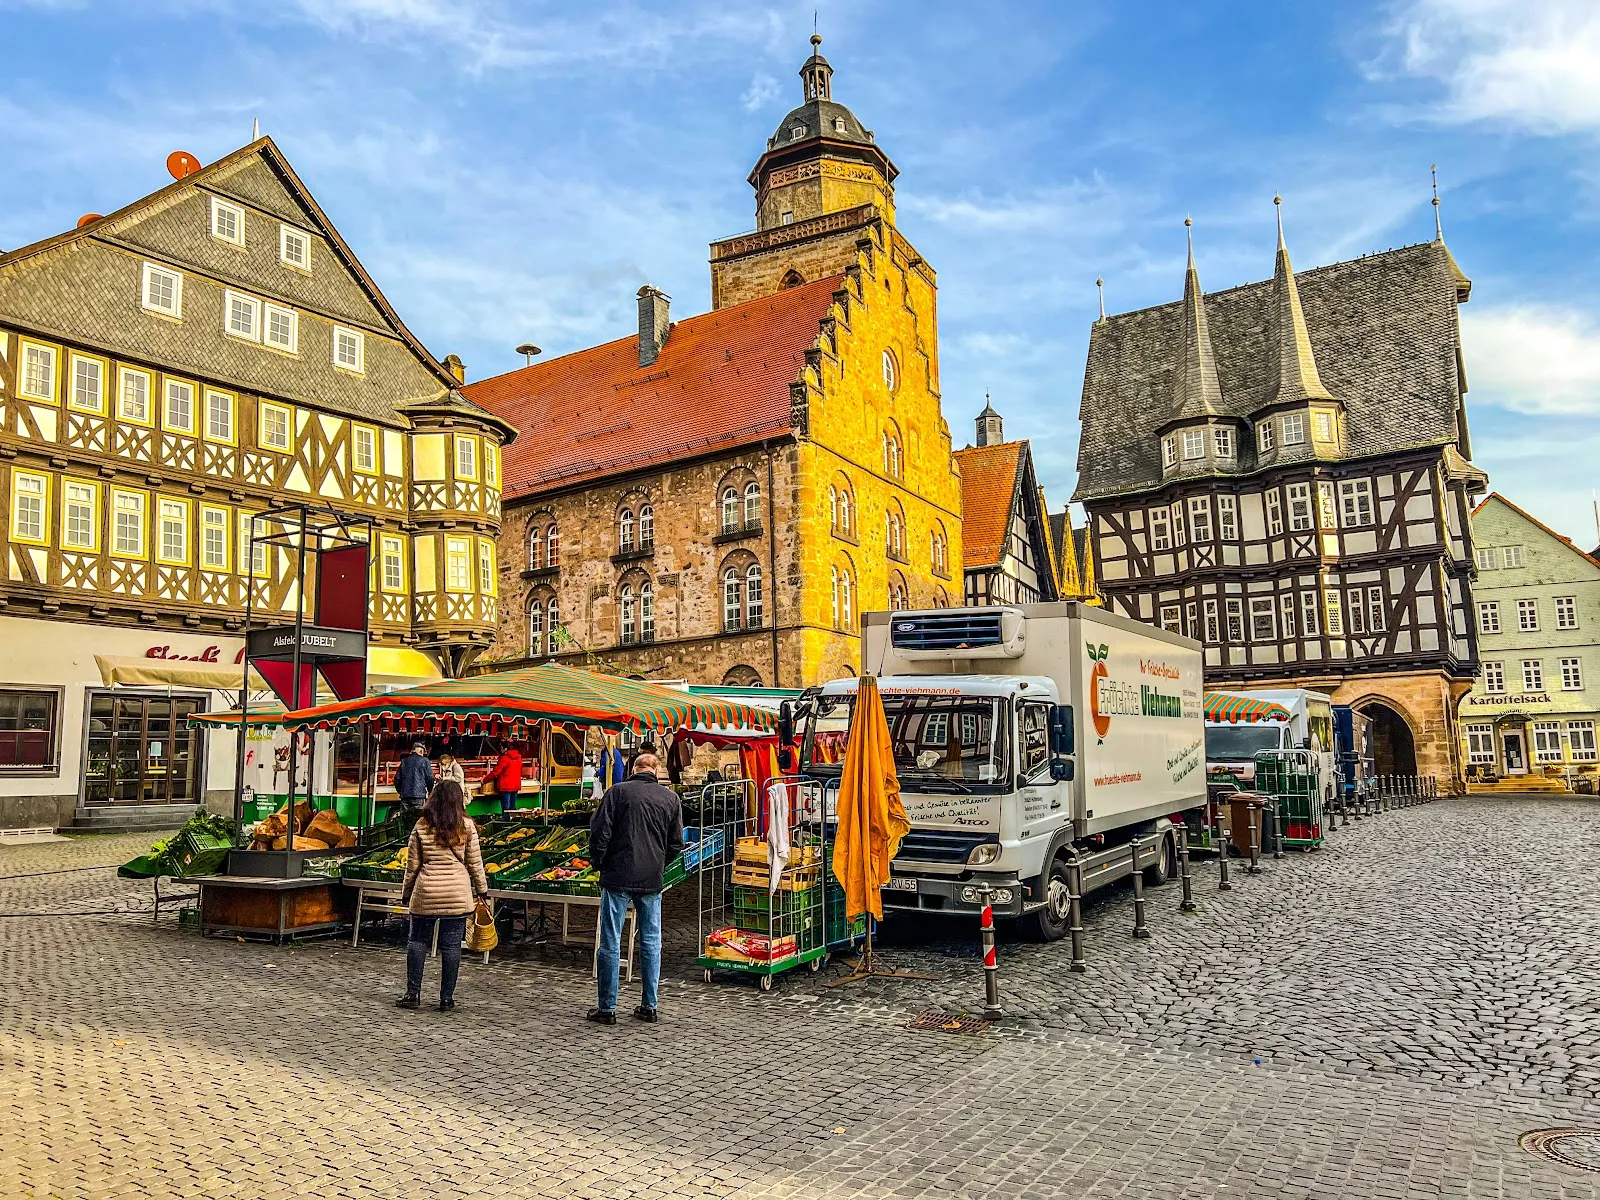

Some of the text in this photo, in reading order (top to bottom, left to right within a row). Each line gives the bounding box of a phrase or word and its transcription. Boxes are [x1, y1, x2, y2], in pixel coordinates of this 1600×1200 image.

[301, 635, 337, 648] JUBELT
[846, 687, 961, 695] wwechte-viehmann.de
[1097, 678, 1140, 716] Früchte
[1140, 684, 1182, 718] Viehmann
[1469, 693, 1552, 706] Kartoffelsack
[1093, 770, 1142, 787] www.fruechte-viehmann.de
[913, 802, 926, 810] und
[926, 800, 950, 810] Gemüse
[934, 810, 947, 819] und
[904, 879, 917, 890] 55
